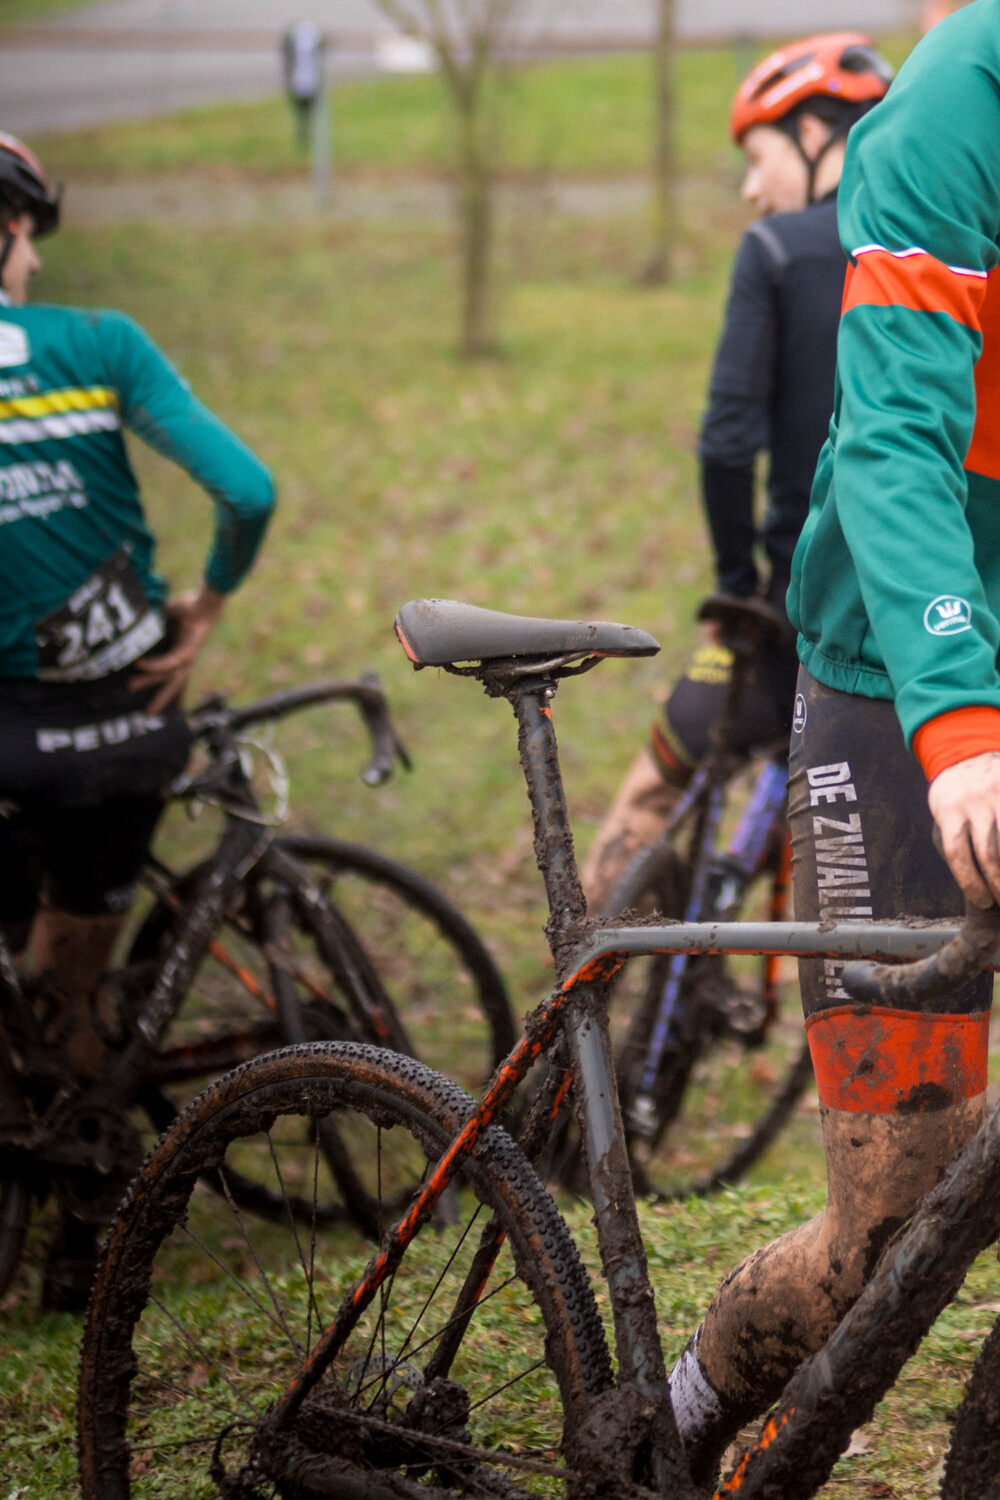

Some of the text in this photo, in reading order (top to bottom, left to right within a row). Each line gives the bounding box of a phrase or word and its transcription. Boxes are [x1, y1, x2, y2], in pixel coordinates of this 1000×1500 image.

[57, 581, 137, 668] 241
[806, 761, 874, 999] DE ZWALU
